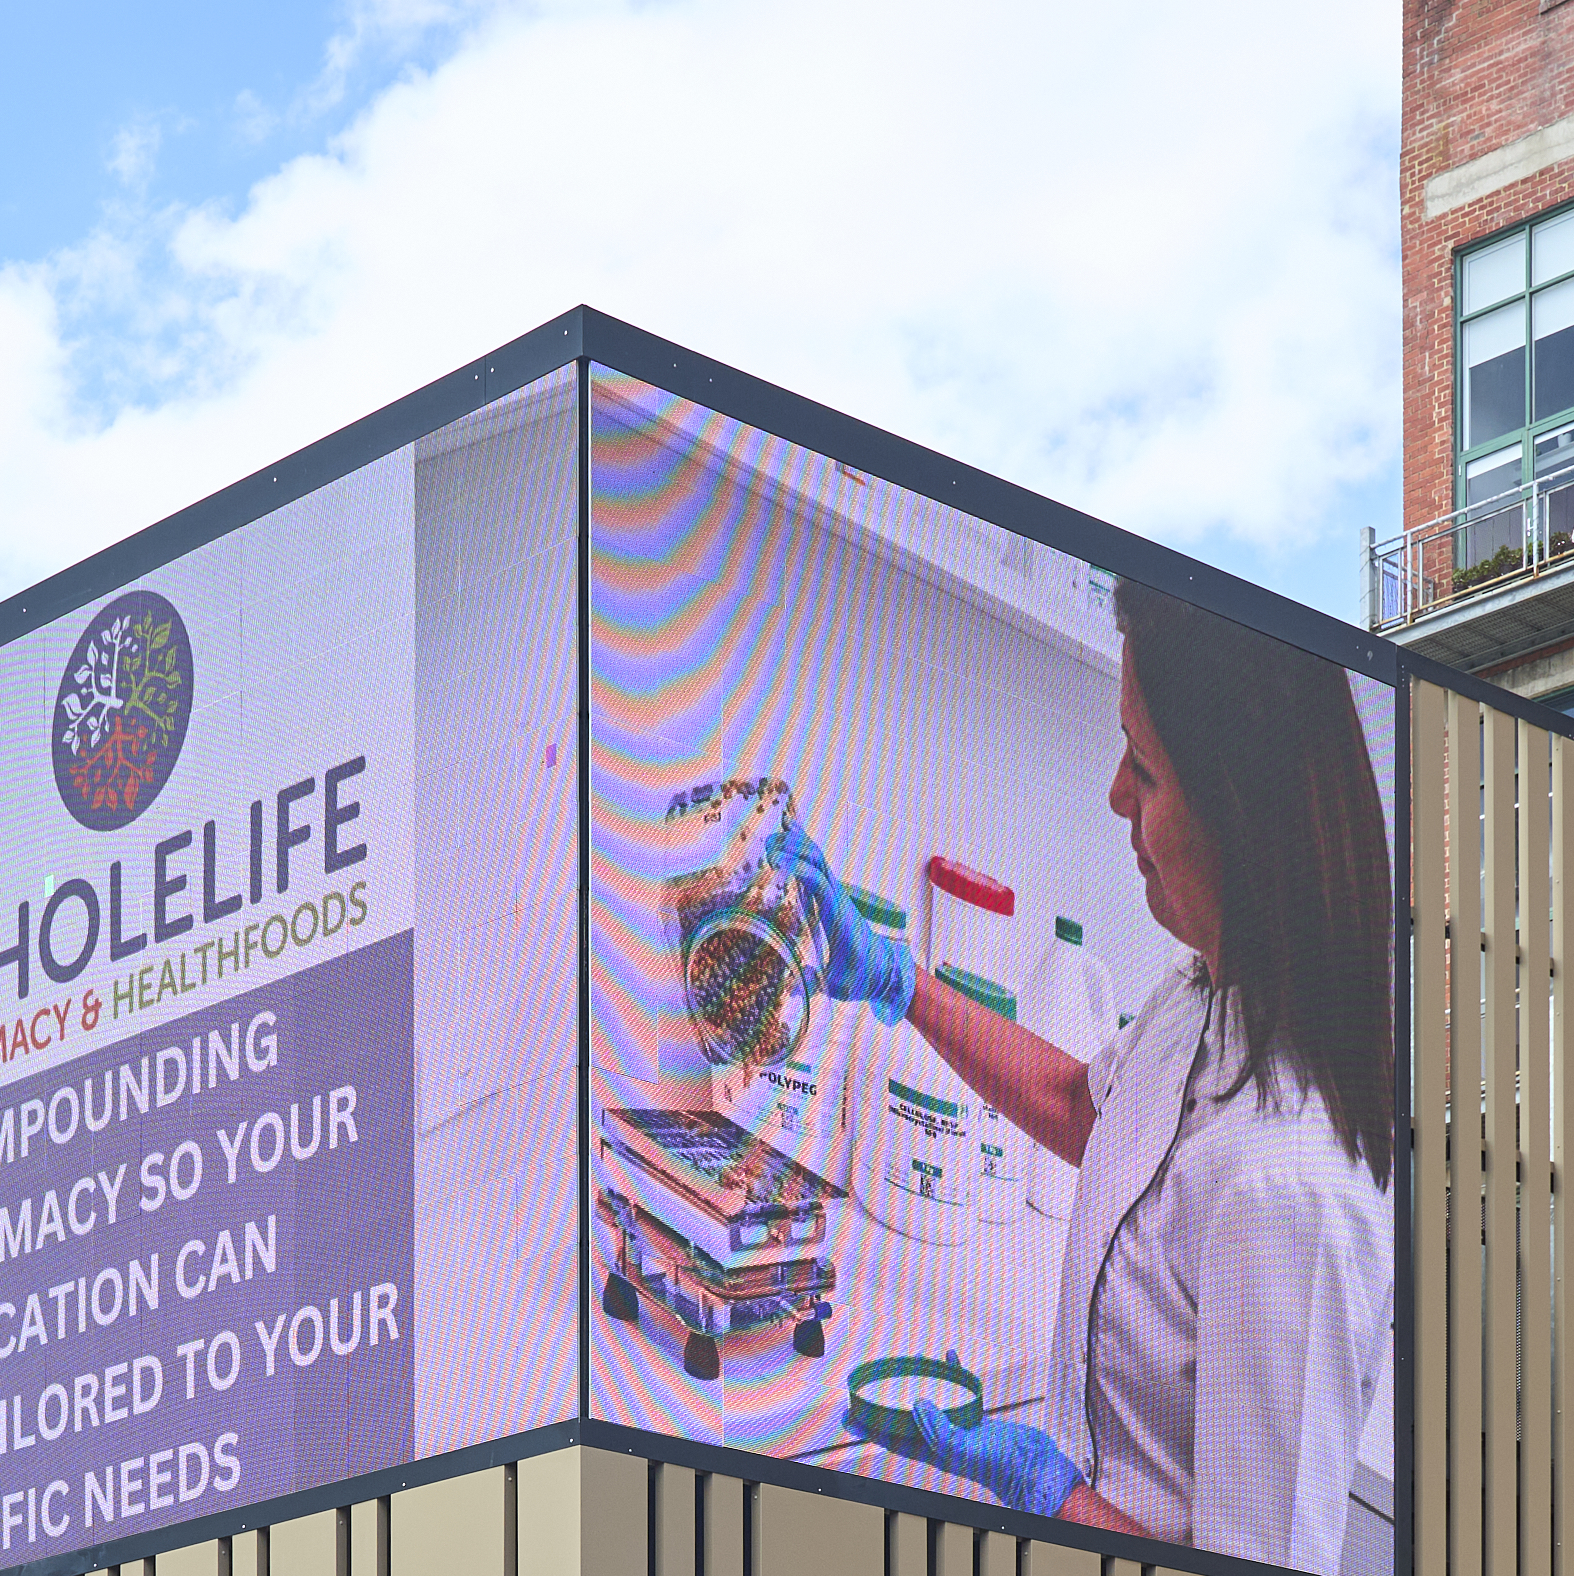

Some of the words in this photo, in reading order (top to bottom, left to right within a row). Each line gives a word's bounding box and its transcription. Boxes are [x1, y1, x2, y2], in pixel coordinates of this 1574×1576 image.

[81, 989, 103, 1032] &
[112, 880, 368, 1020] HEALTHFOODS
[139, 1140, 204, 1213] SO
[216, 1084, 359, 1183] YOUR
[175, 1214, 277, 1300] CAN
[177, 1330, 241, 1400] TO
[254, 1282, 400, 1379] YOUR
[84, 1432, 241, 1528] NEEDS
